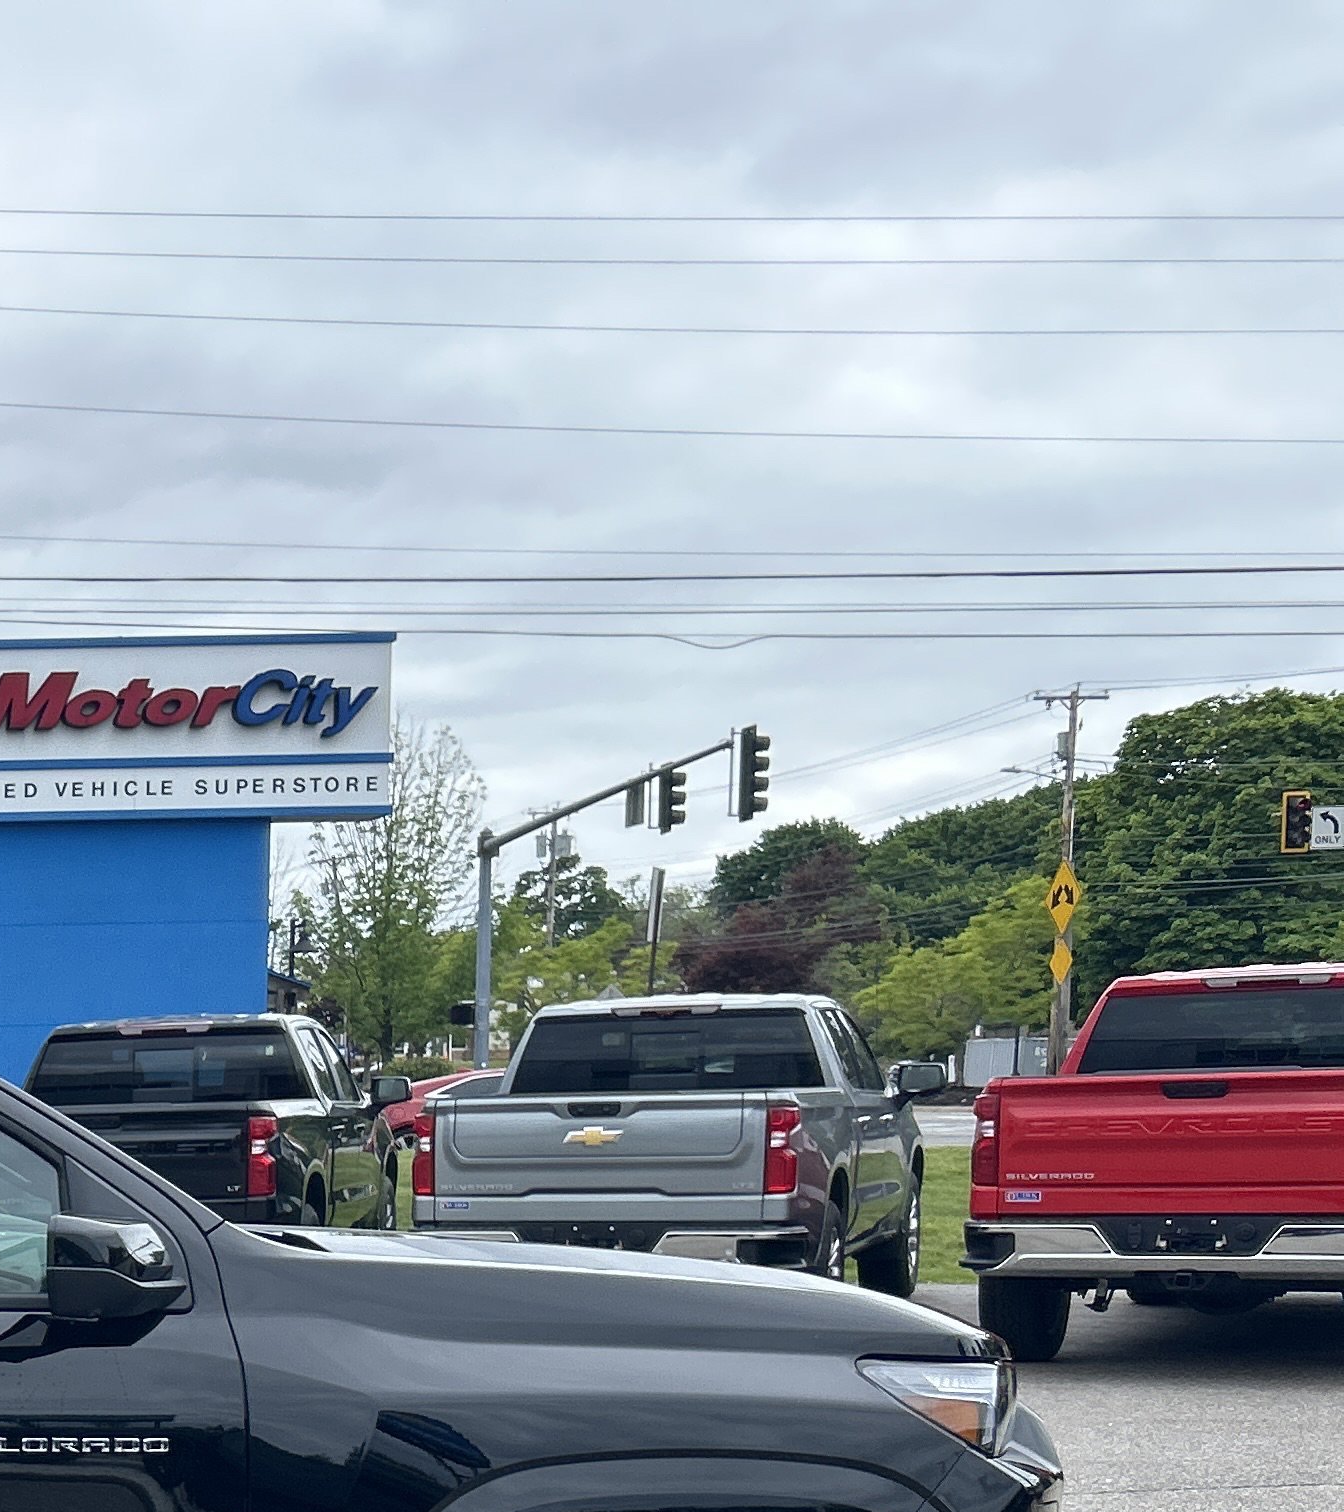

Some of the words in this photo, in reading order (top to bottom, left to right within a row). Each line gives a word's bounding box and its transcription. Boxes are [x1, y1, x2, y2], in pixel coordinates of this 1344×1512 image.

[54, 779, 175, 798] VEHICLE
[194, 775, 379, 796] SUPERSTORE
[1314, 835, 1341, 845] ONLY
[1023, 1115, 1344, 1137] CHEVROLE
[1005, 1172, 1095, 1181] SILVERADO
